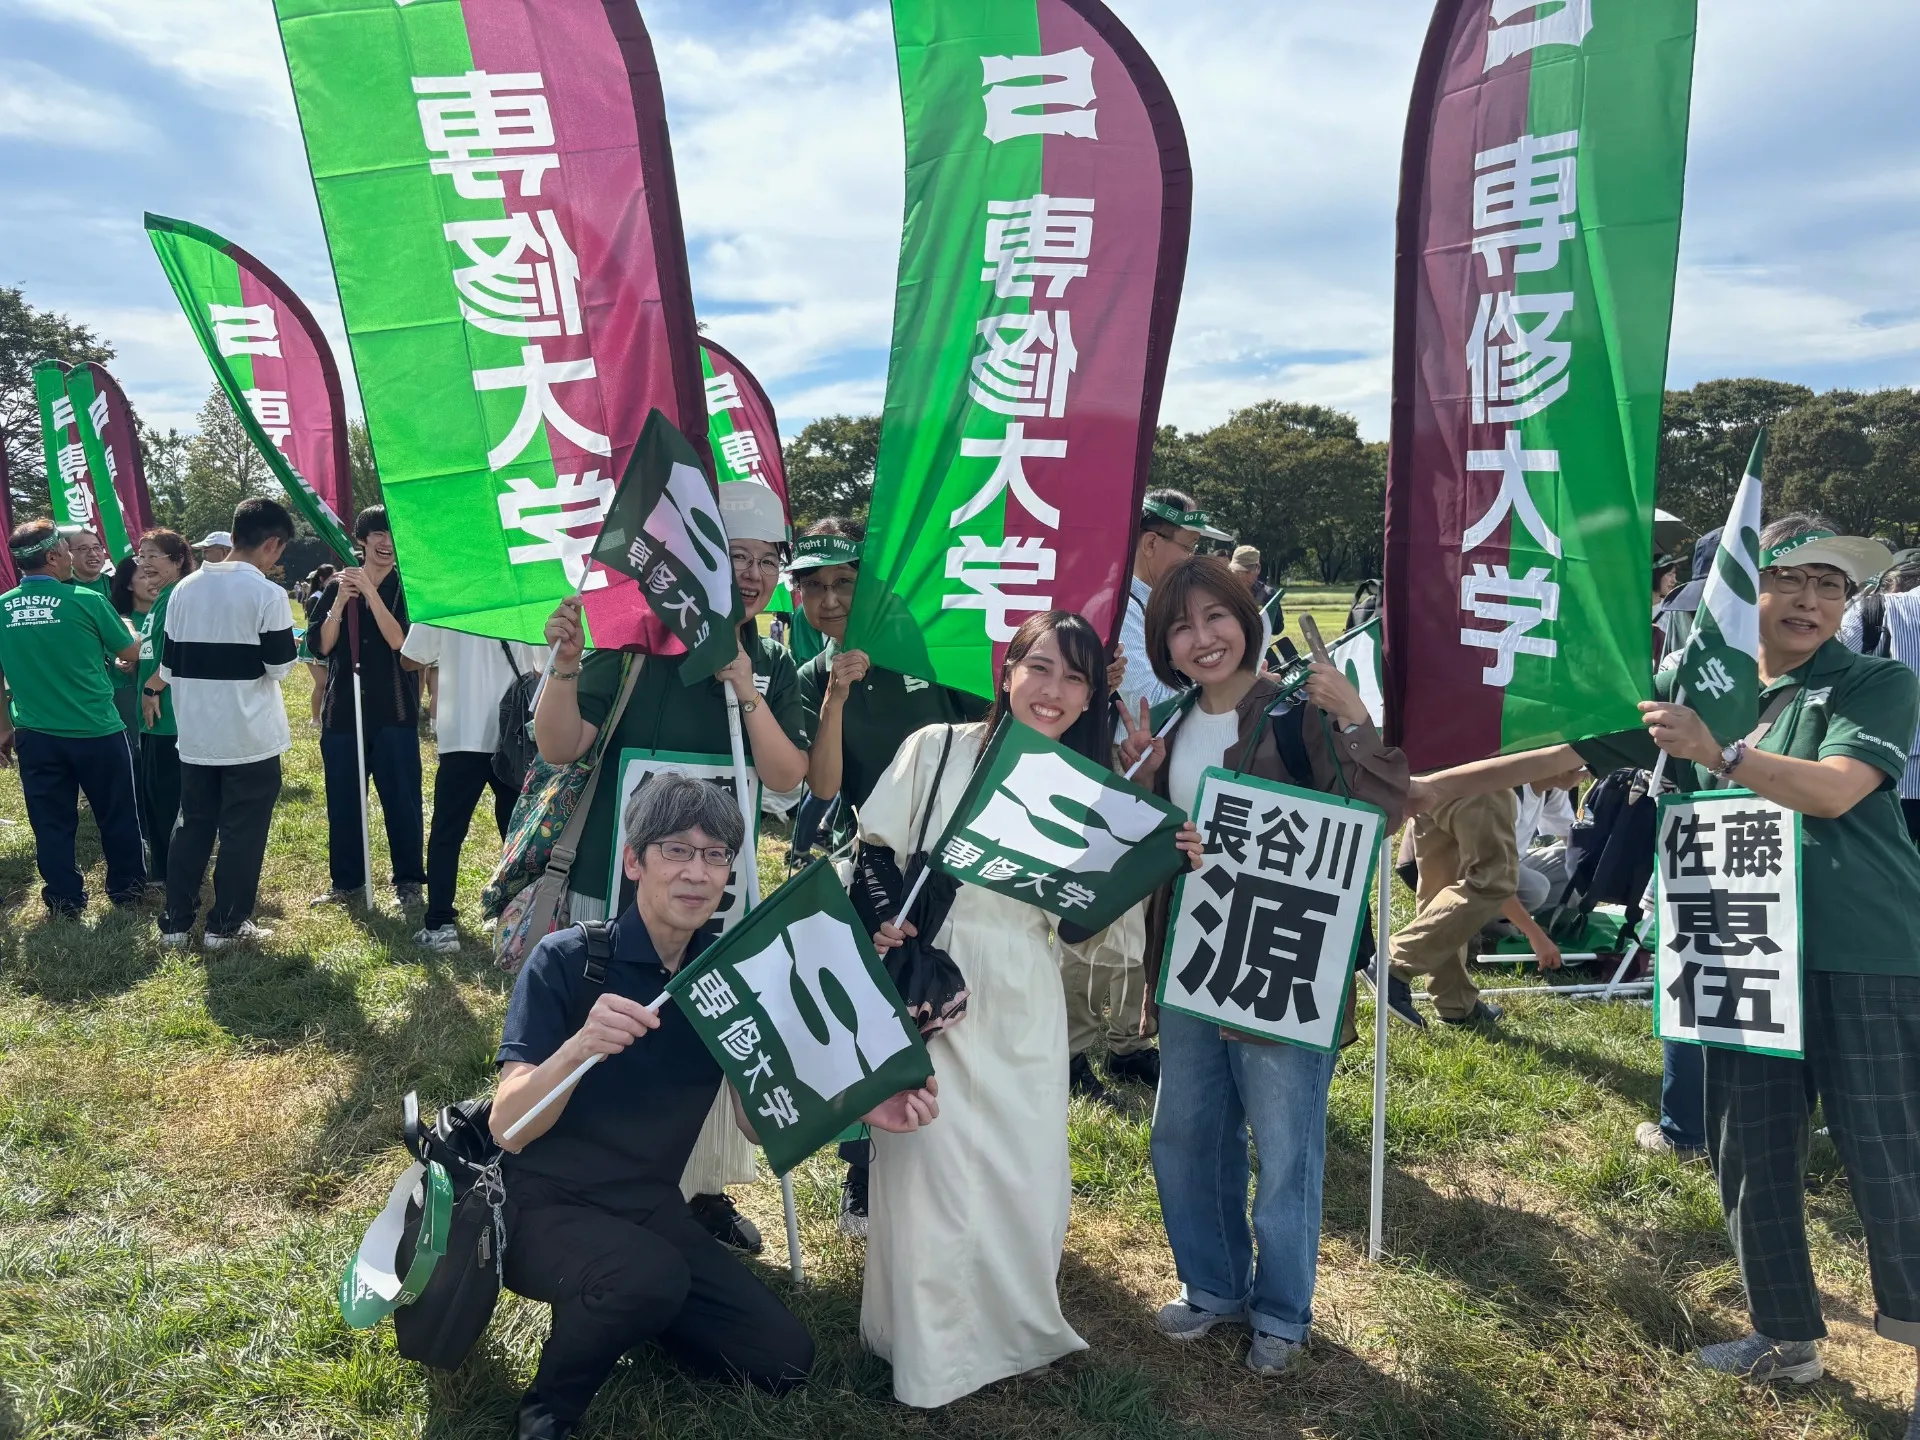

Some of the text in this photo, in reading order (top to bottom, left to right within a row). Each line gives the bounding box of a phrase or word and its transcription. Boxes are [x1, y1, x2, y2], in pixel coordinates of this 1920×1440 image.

[1461, 129, 1579, 687] 専修大学
[4, 595, 61, 611] SENSHU
[1857, 731, 1882, 745] SENSHU
[940, 835, 1097, 910] 専修大学
[1202, 793, 1363, 890] 長谷川
[1665, 809, 1783, 879] 佐藤
[1177, 863, 1341, 1025] 源
[1666, 888, 1785, 1035] 恵伍
[688, 968, 800, 1129] 専修大学
